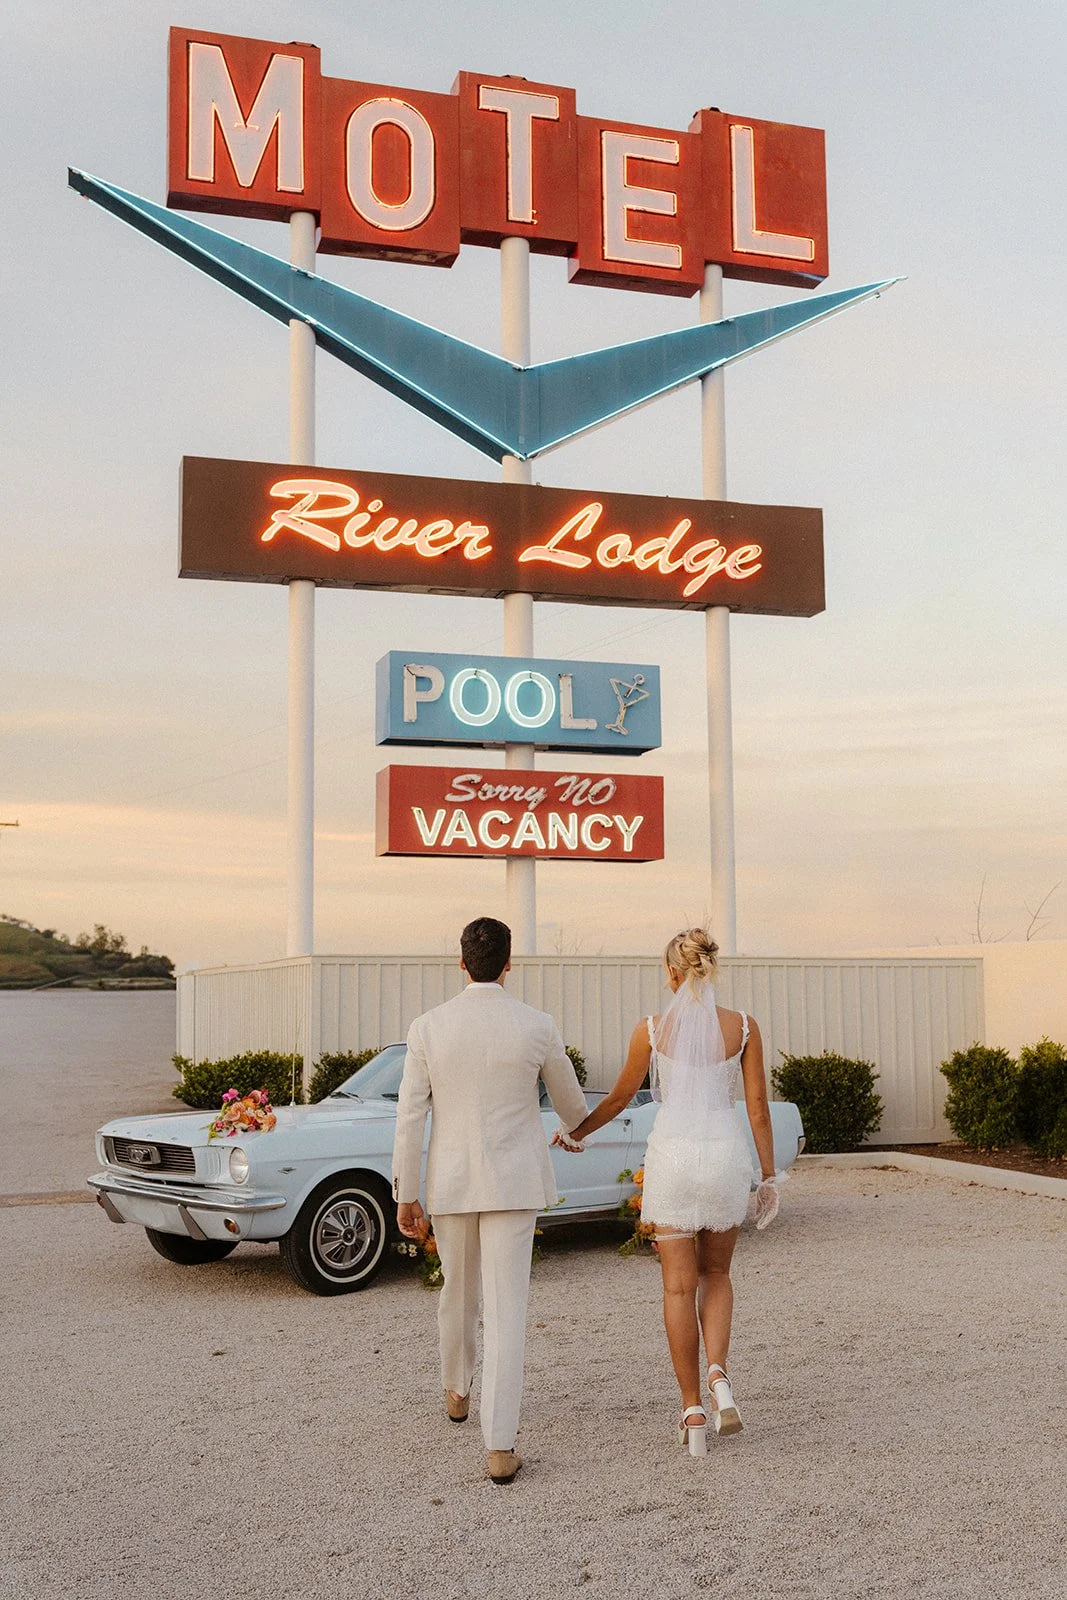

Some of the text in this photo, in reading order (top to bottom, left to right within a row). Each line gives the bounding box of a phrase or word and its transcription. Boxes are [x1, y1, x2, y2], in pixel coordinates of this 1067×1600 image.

[187, 41, 816, 270] MOTEL
[261, 478, 763, 597] River Lodge
[403, 663, 597, 730] POOL
[445, 774, 617, 810] Sorry NO
[411, 806, 644, 852] VACANCY
